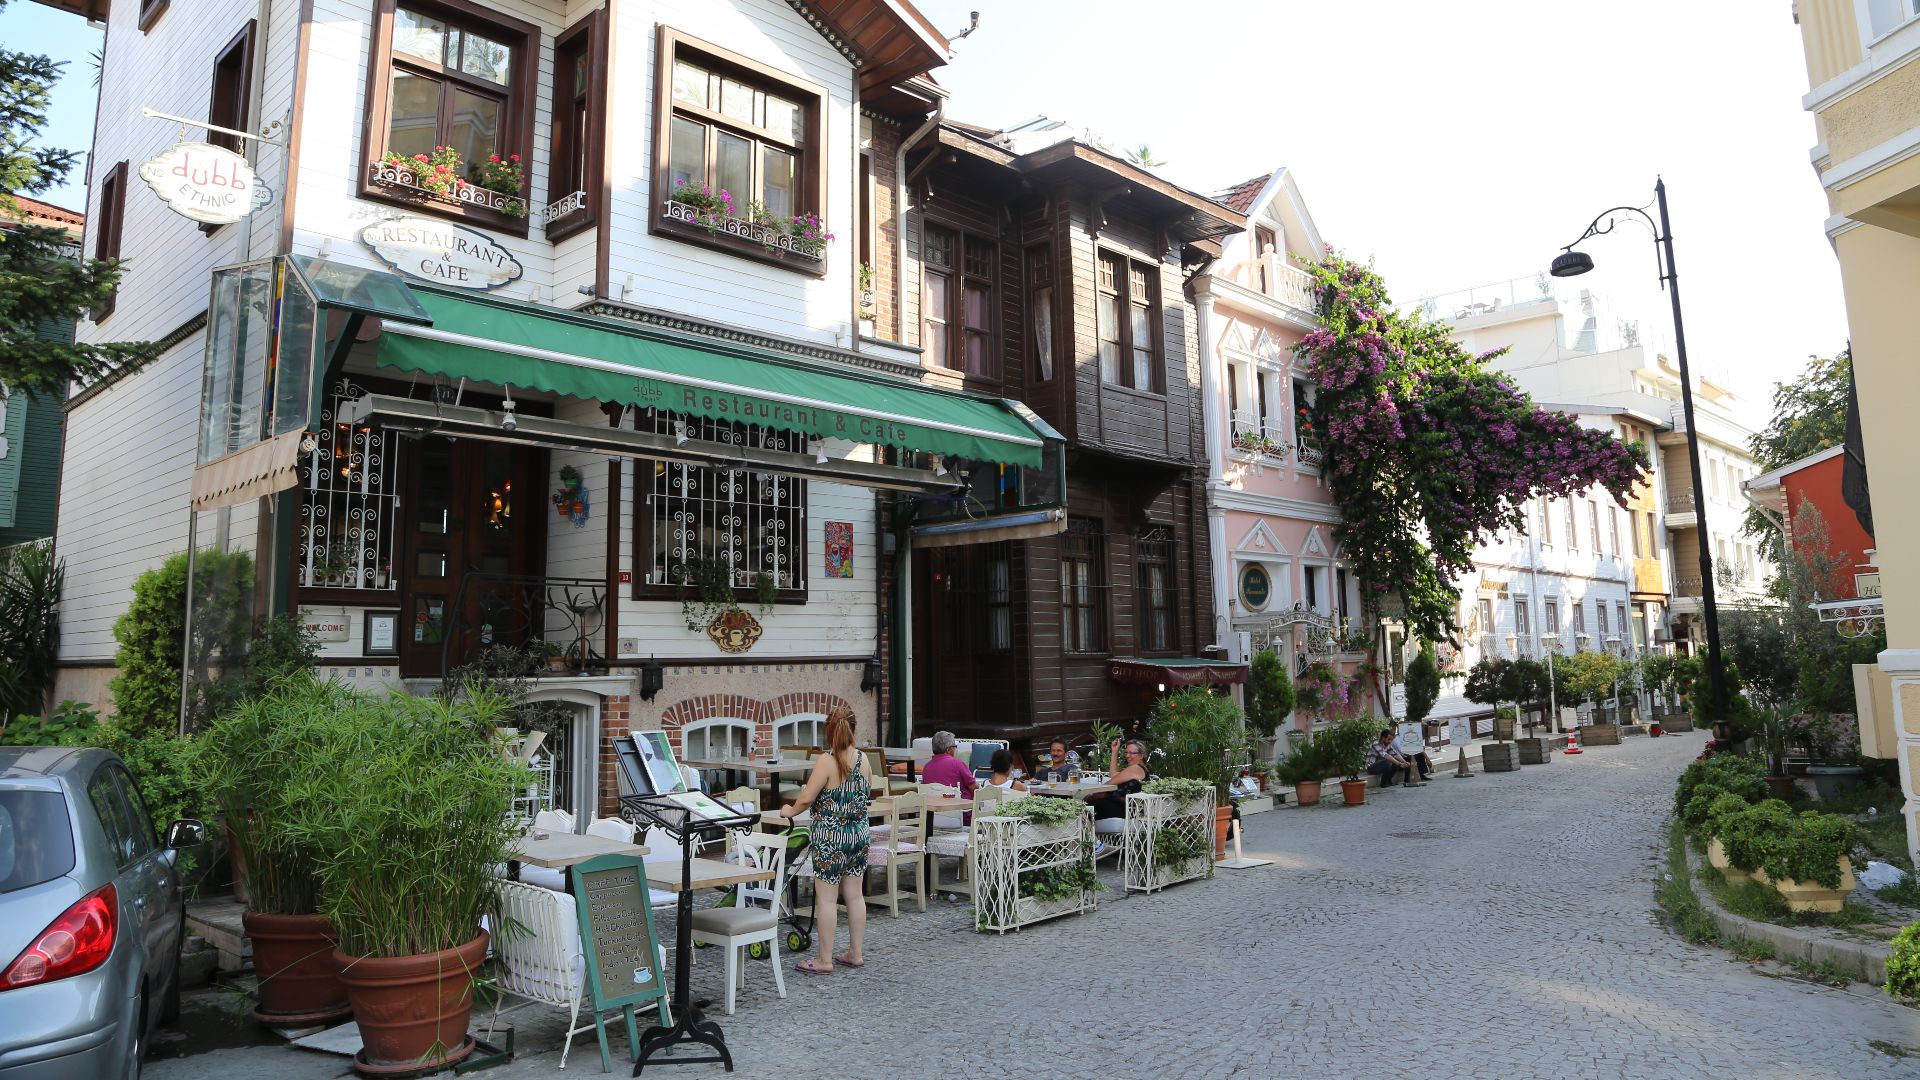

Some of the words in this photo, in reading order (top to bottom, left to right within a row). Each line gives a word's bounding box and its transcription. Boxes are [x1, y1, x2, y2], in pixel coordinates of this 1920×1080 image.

[179, 183, 236, 207] ETHNIC
[255, 189, 267, 199] 25
[382, 227, 507, 269] RESTAURANT
[441, 252, 452, 262] &
[420, 259, 469, 281] CAFE
[683, 388, 818, 428] Restaurant
[835, 414, 847, 433] &
[860, 419, 906, 441] Cafe
[305, 623, 345, 632] WELCOME
